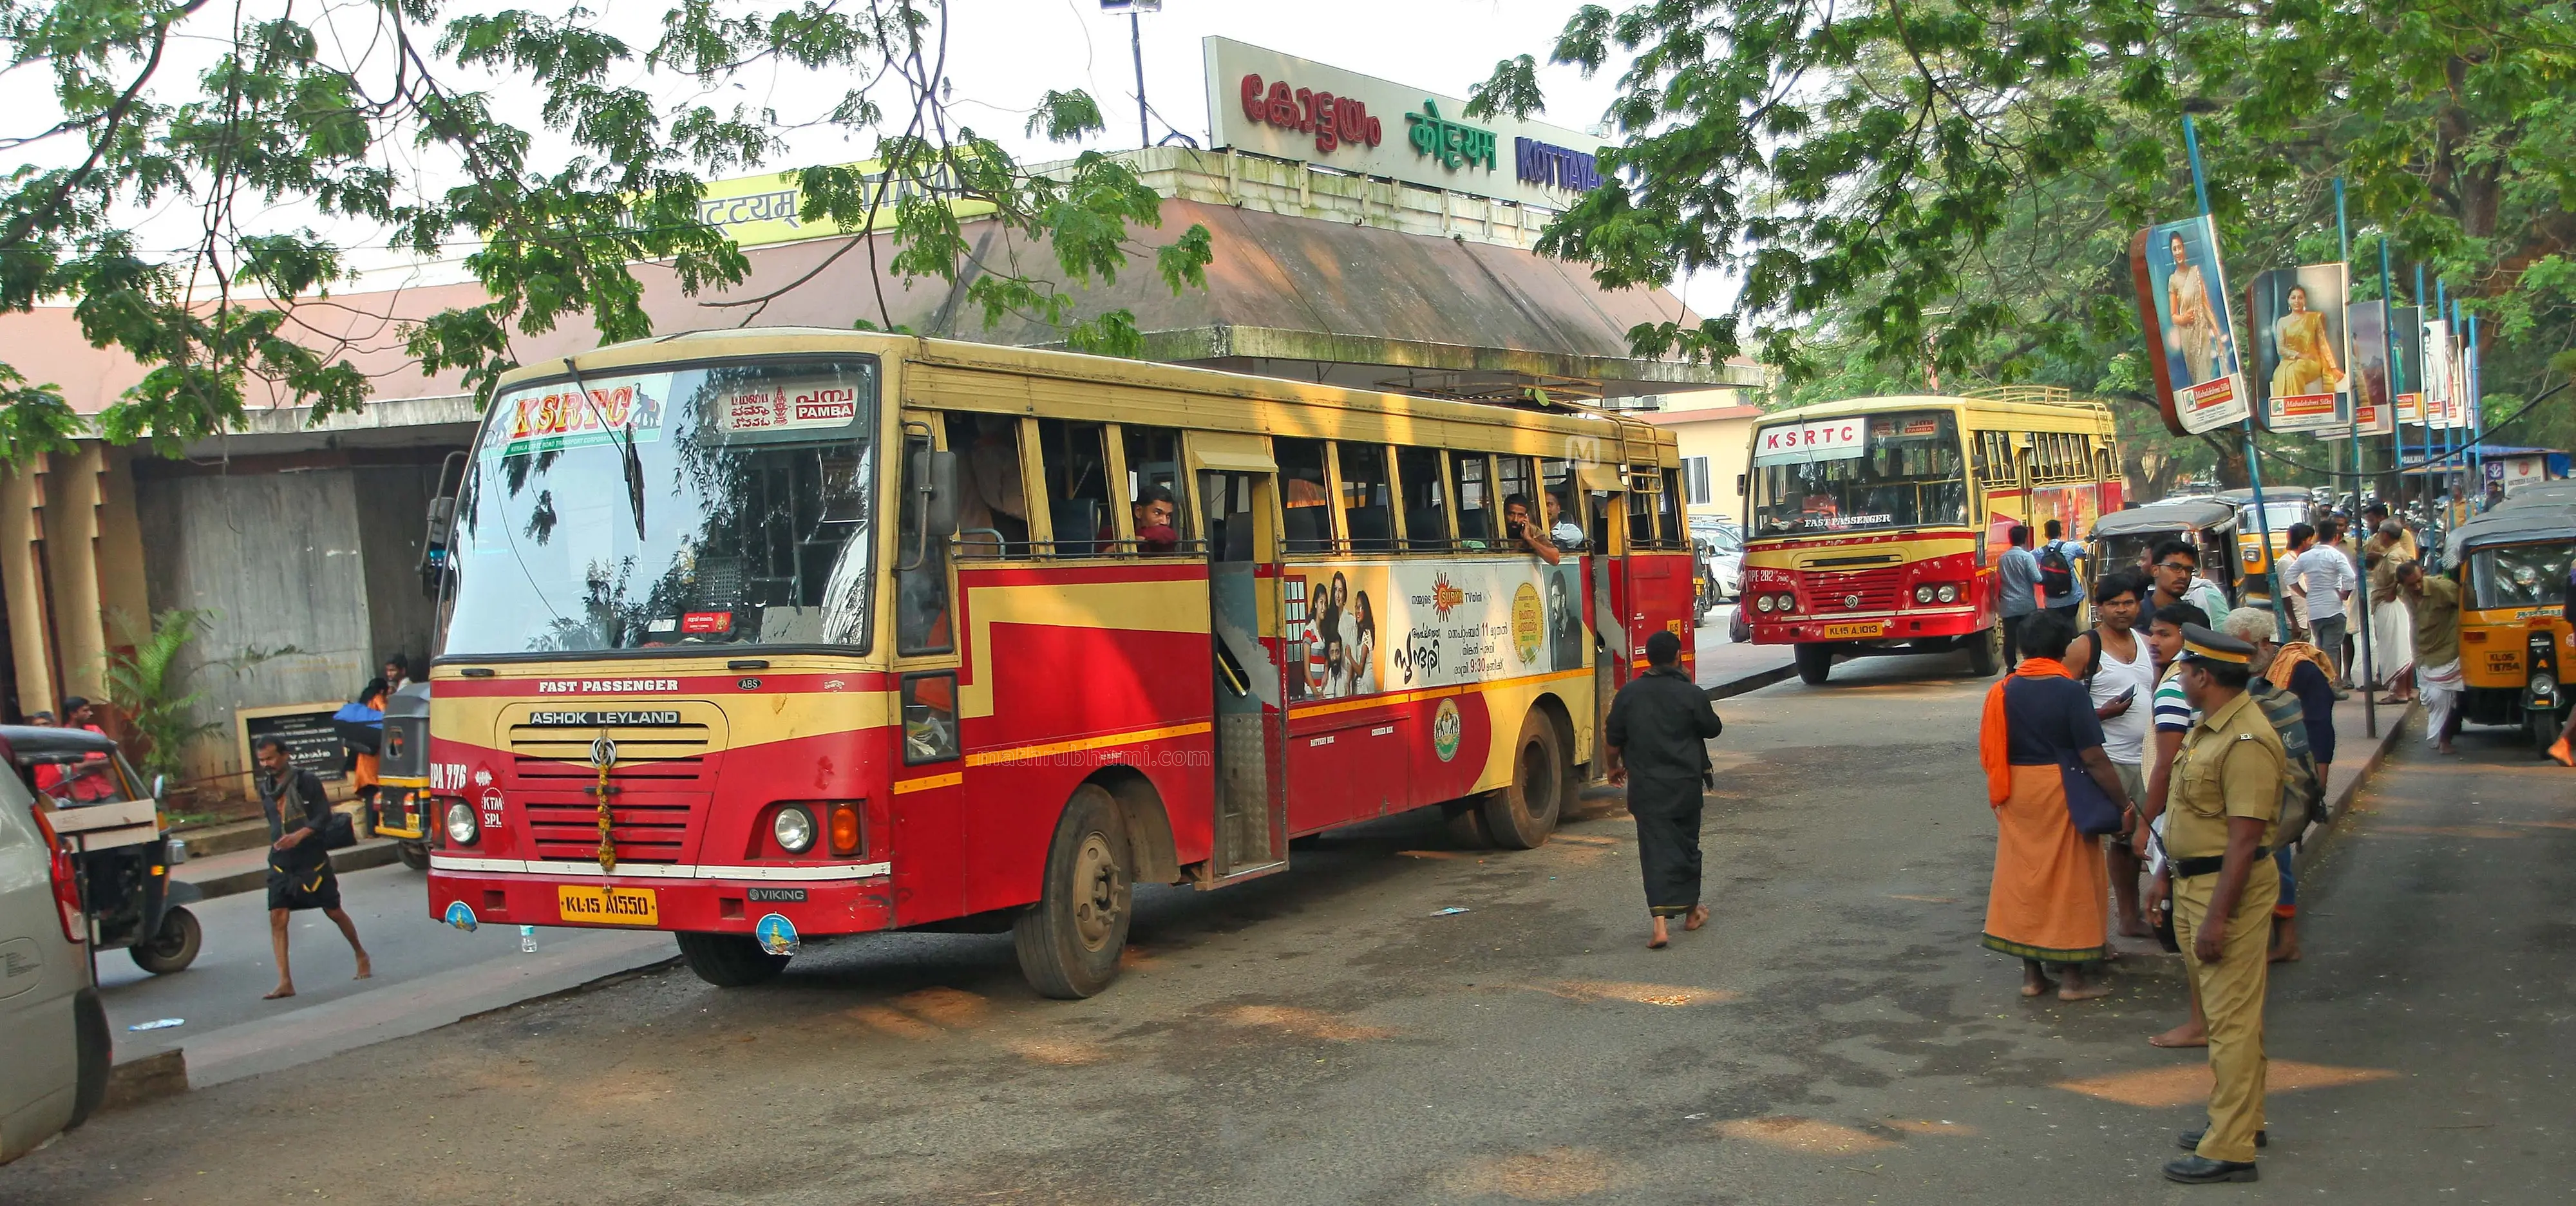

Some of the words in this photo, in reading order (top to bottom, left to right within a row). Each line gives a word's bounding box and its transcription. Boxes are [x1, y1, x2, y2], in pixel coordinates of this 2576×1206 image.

[1241, 73, 1382, 153] കോട്ടയം
[1514, 136, 1605, 194] KOTTAYA
[509, 385, 634, 439] KSRTC
[799, 404, 852, 418] PAMBA
[1804, 519, 1832, 528] FAST
[1832, 514, 1891, 527] PASSENGER
[1760, 569, 1774, 582] 282
[1441, 590, 1464, 604] SURYA
[1481, 622, 1489, 637] 11
[1470, 657, 1486, 673] 9:30
[538, 681, 578, 693] FAST
[582, 679, 679, 692] PASSENGER
[741, 679, 758, 689] ABS
[531, 712, 587, 724] ASHOK
[596, 711, 677, 724] LEYLAND
[446, 763, 468, 790] 776
[484, 796, 504, 811] KTM
[760, 890, 805, 900] VIKING
[605, 895, 649, 916] A1550
